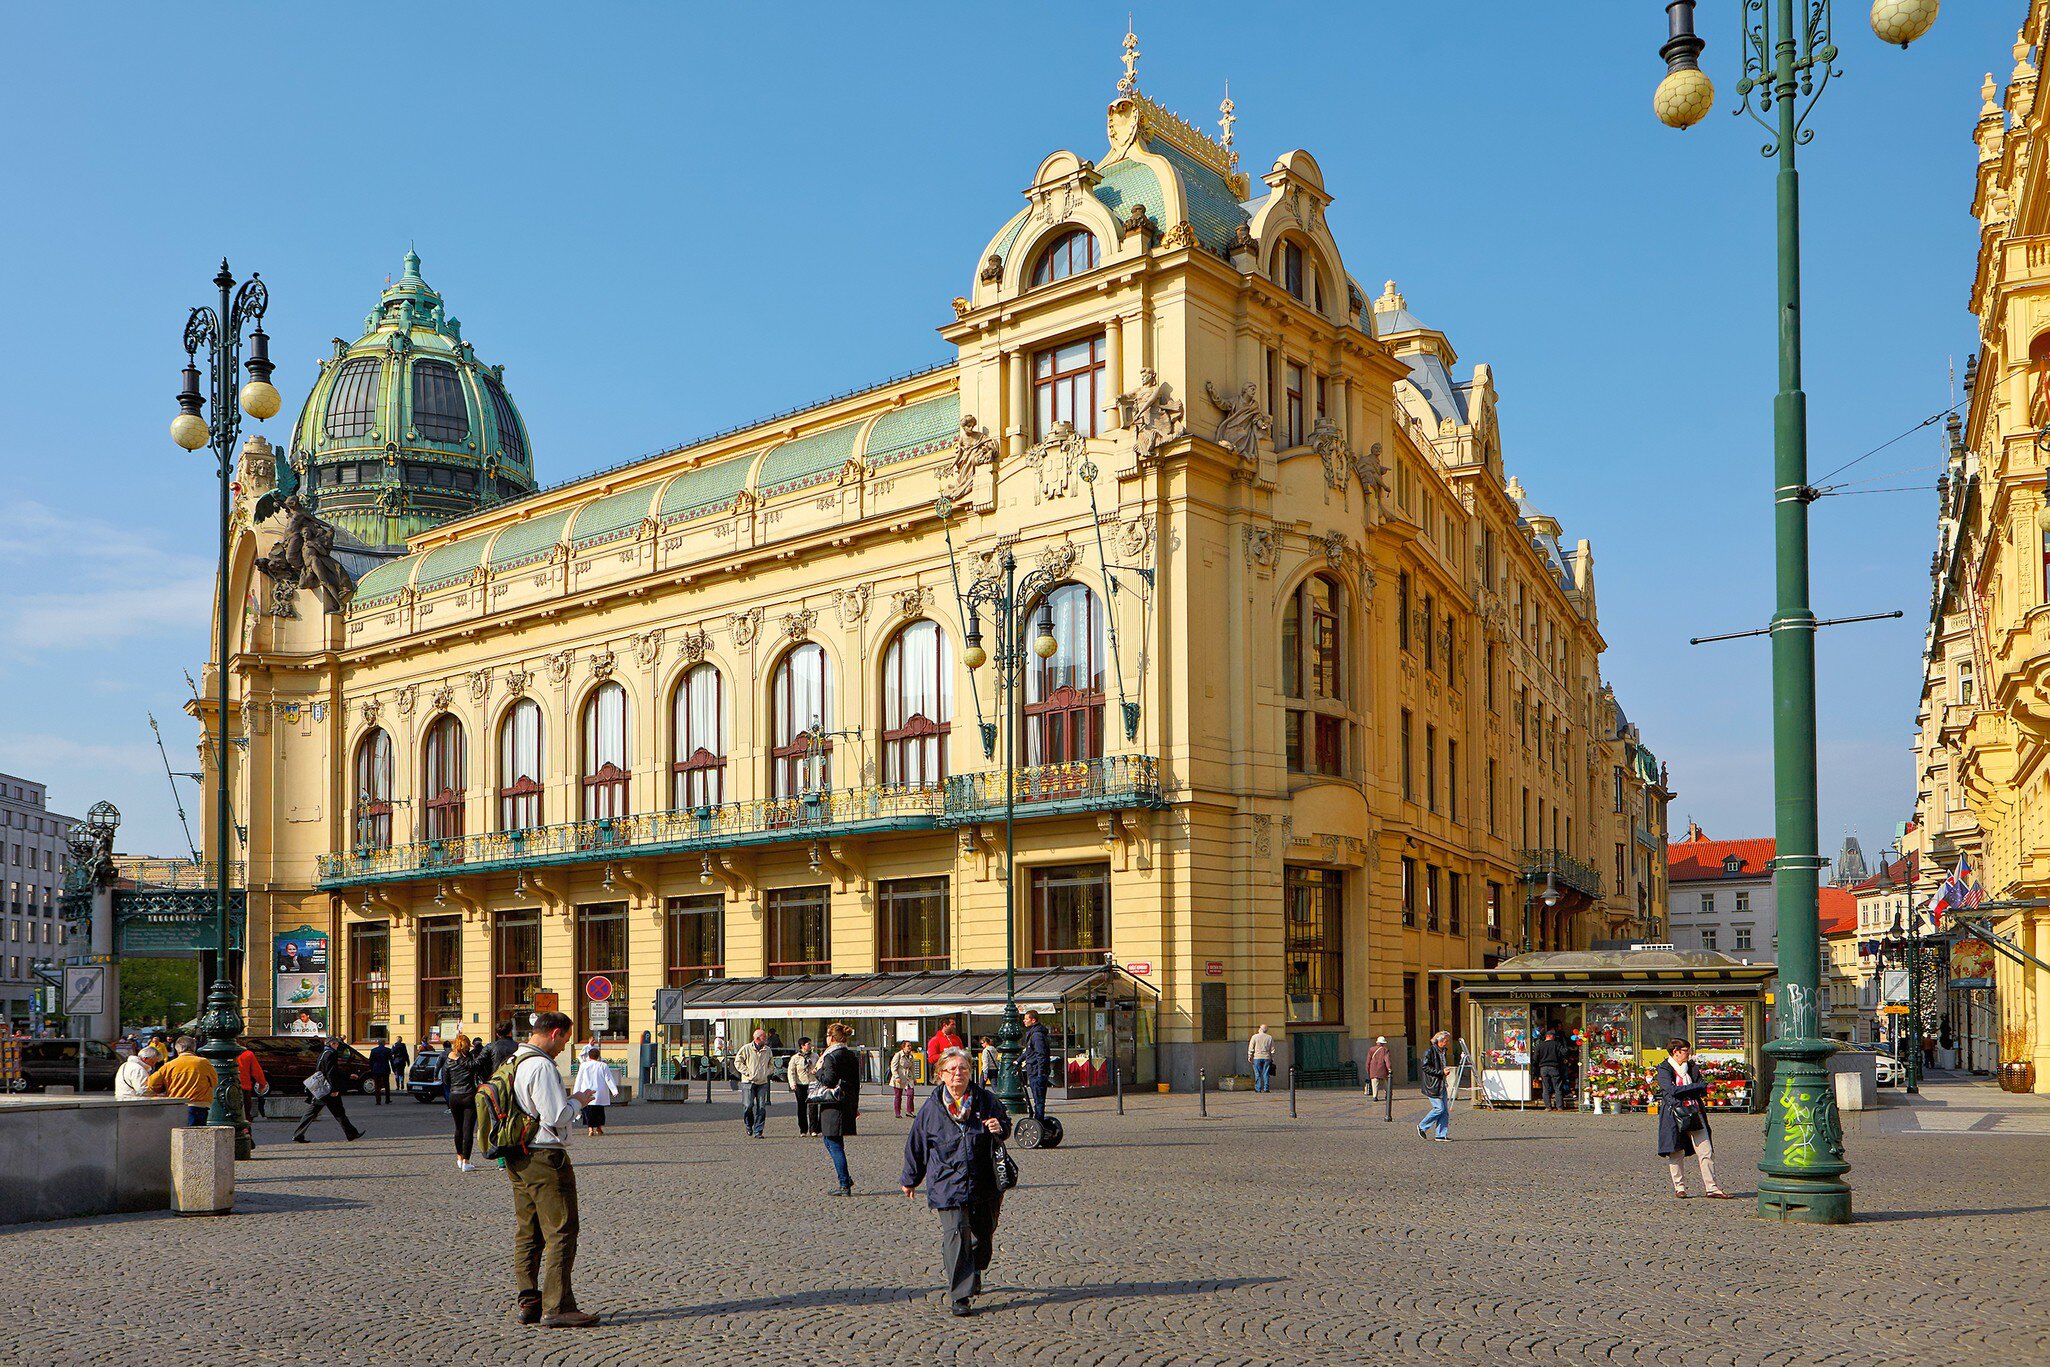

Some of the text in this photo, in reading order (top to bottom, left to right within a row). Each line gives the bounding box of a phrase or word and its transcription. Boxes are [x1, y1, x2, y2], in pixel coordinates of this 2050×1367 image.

[1510, 991, 1551, 999] FLOWERS
[1672, 990, 1710, 998] BLUMEN
[995, 1159, 1010, 1186] YORK
